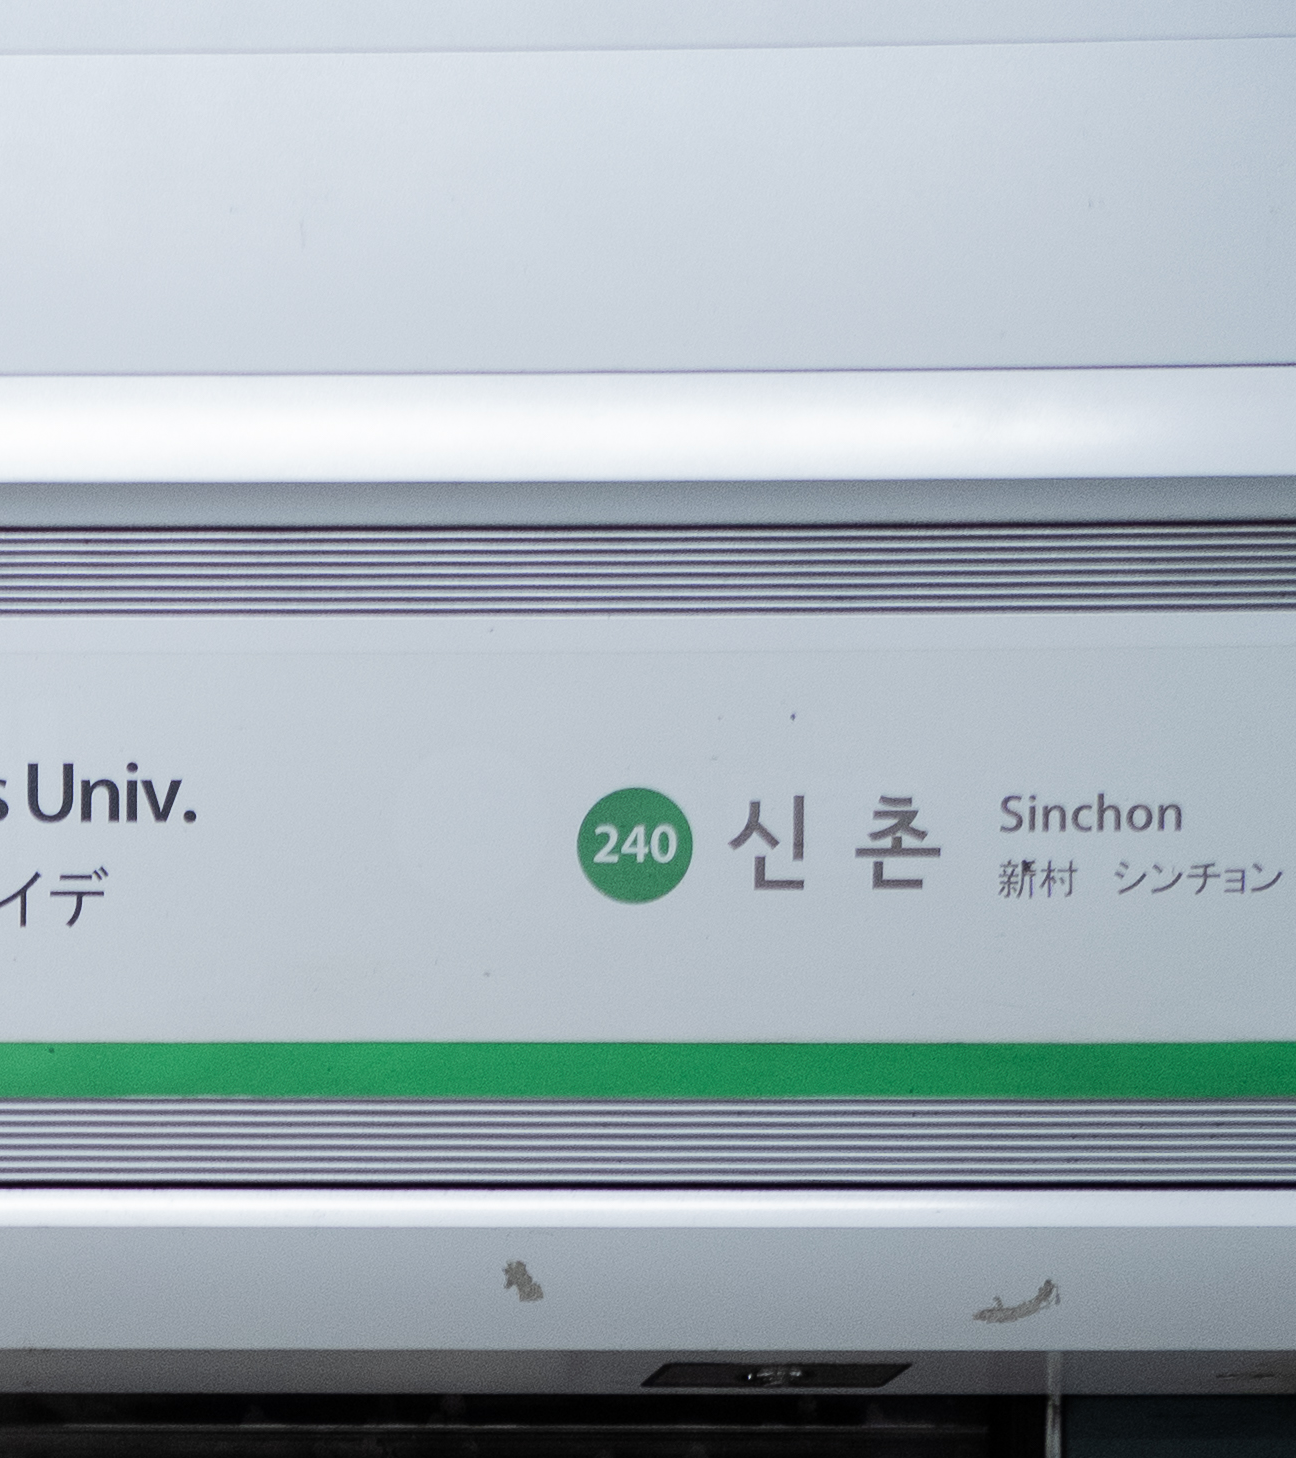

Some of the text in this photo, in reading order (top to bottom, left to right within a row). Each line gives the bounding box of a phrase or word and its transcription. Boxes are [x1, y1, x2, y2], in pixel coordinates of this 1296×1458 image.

[25, 761, 200, 824] Univ.
[999, 793, 1183, 833] Sinchon
[593, 824, 677, 865] 240
[1113, 861, 1283, 896] シンチョン
